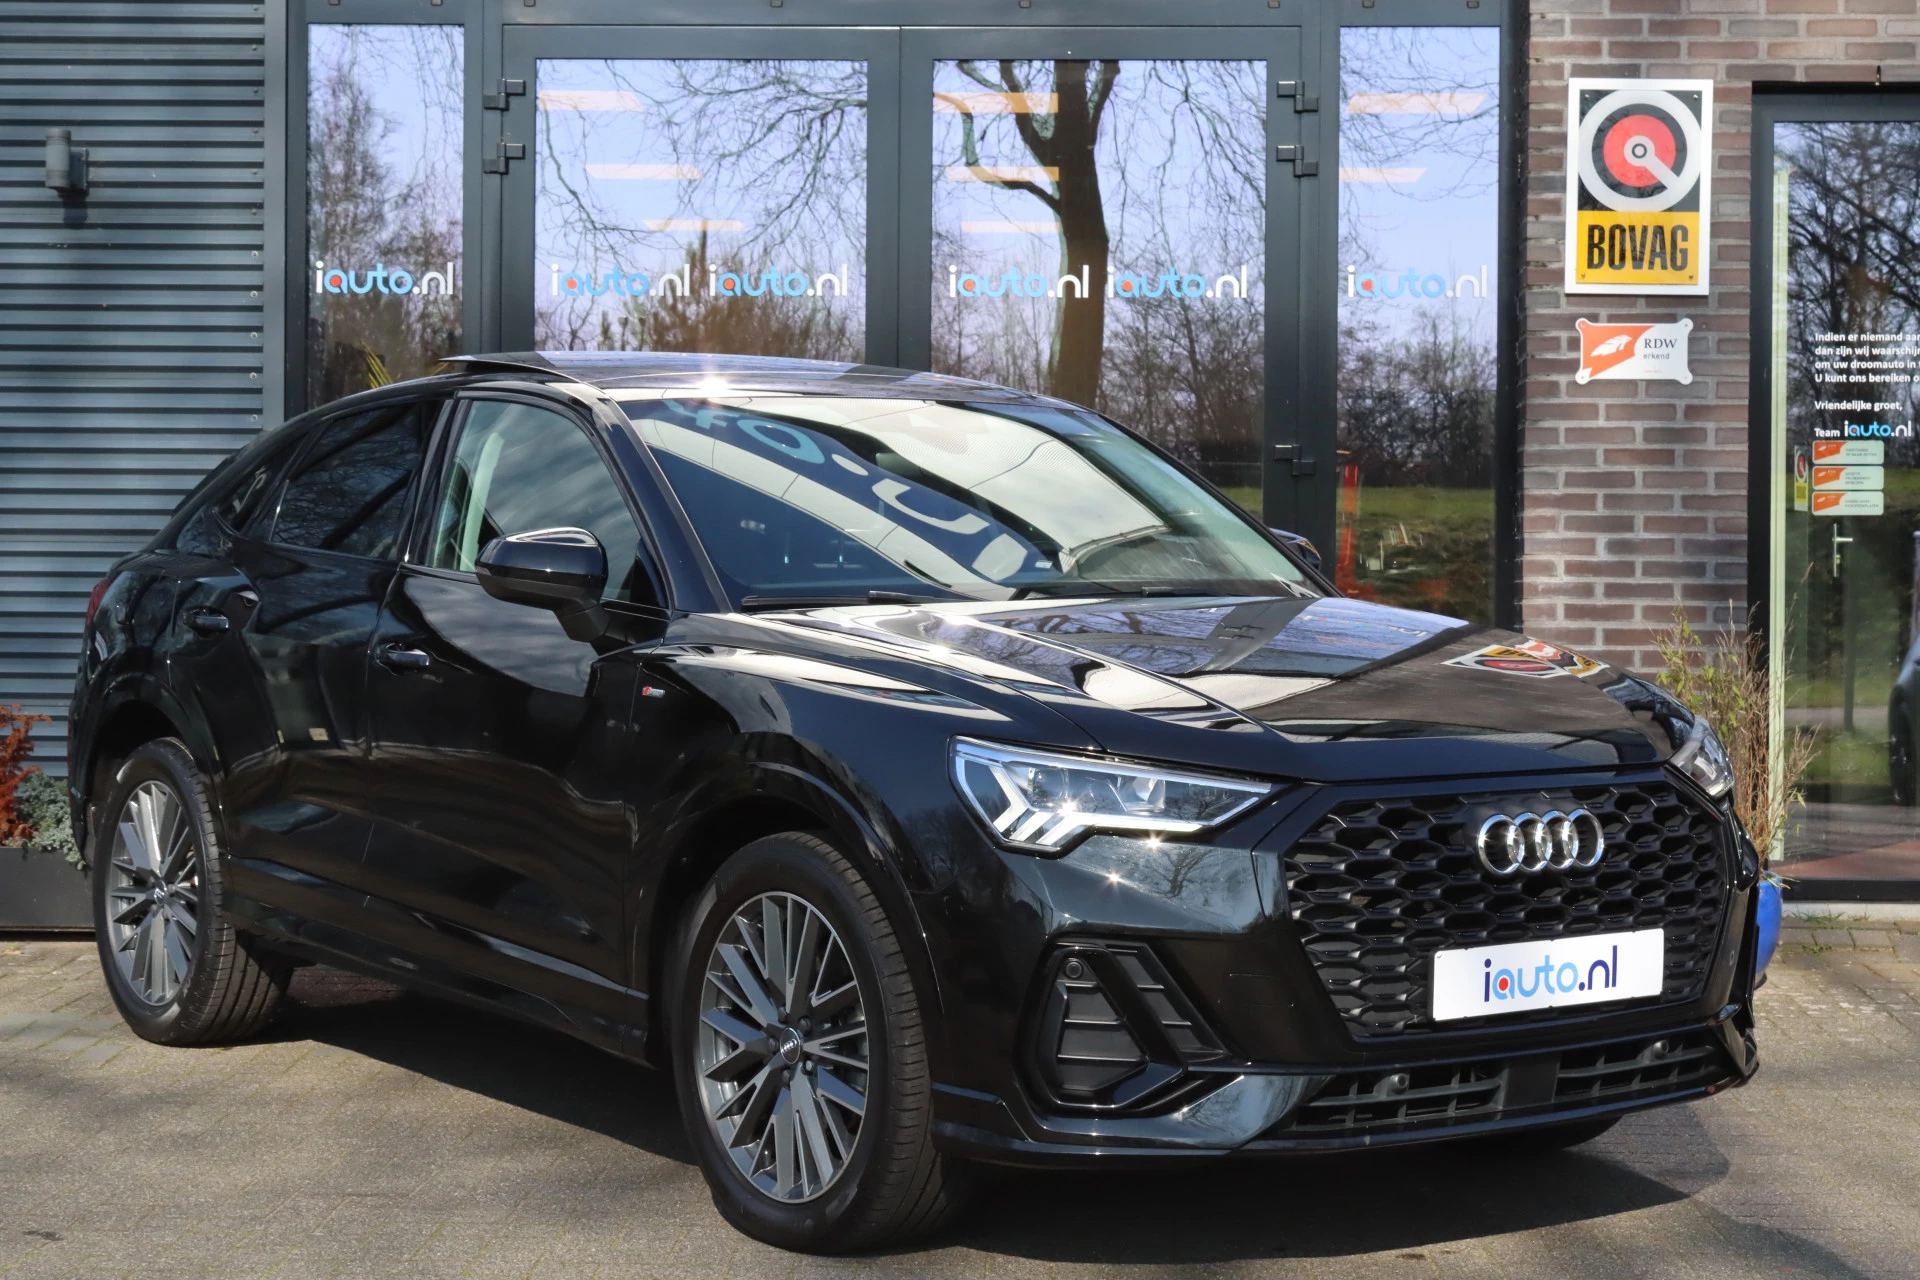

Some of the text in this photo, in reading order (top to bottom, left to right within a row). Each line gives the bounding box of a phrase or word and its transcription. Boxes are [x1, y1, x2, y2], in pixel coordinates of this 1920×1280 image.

[1587, 224, 1689, 271] BOVAG
[315, 260, 454, 295] iauto.nl
[552, 263, 691, 297] iauto.nl
[709, 263, 848, 297] iauto.nl
[949, 264, 1090, 299] iauto.nl
[1107, 265, 1248, 299] iauto.nl
[1347, 264, 1488, 298] iauto.nl
[1644, 338, 1677, 349] RDW
[1815, 332, 1846, 341] Indien
[1848, 333, 1858, 341] er
[1860, 332, 1903, 341] niemand
[1815, 346, 1833, 355] dan
[1836, 346, 1852, 357] zijn
[1855, 346, 1870, 357] wij
[1815, 374, 1822, 382] U
[1825, 373, 1847, 382] kunt
[1869, 373, 1910, 382] bereiken
[1850, 359, 1905, 368] droomauto
[1907, 360, 1916, 368] in
[1814, 400, 1903, 411] Vriendelijke groet,
[1814, 420, 1911, 437] Team iauto.nl
[1484, 945, 1618, 1002] iauto.nl
